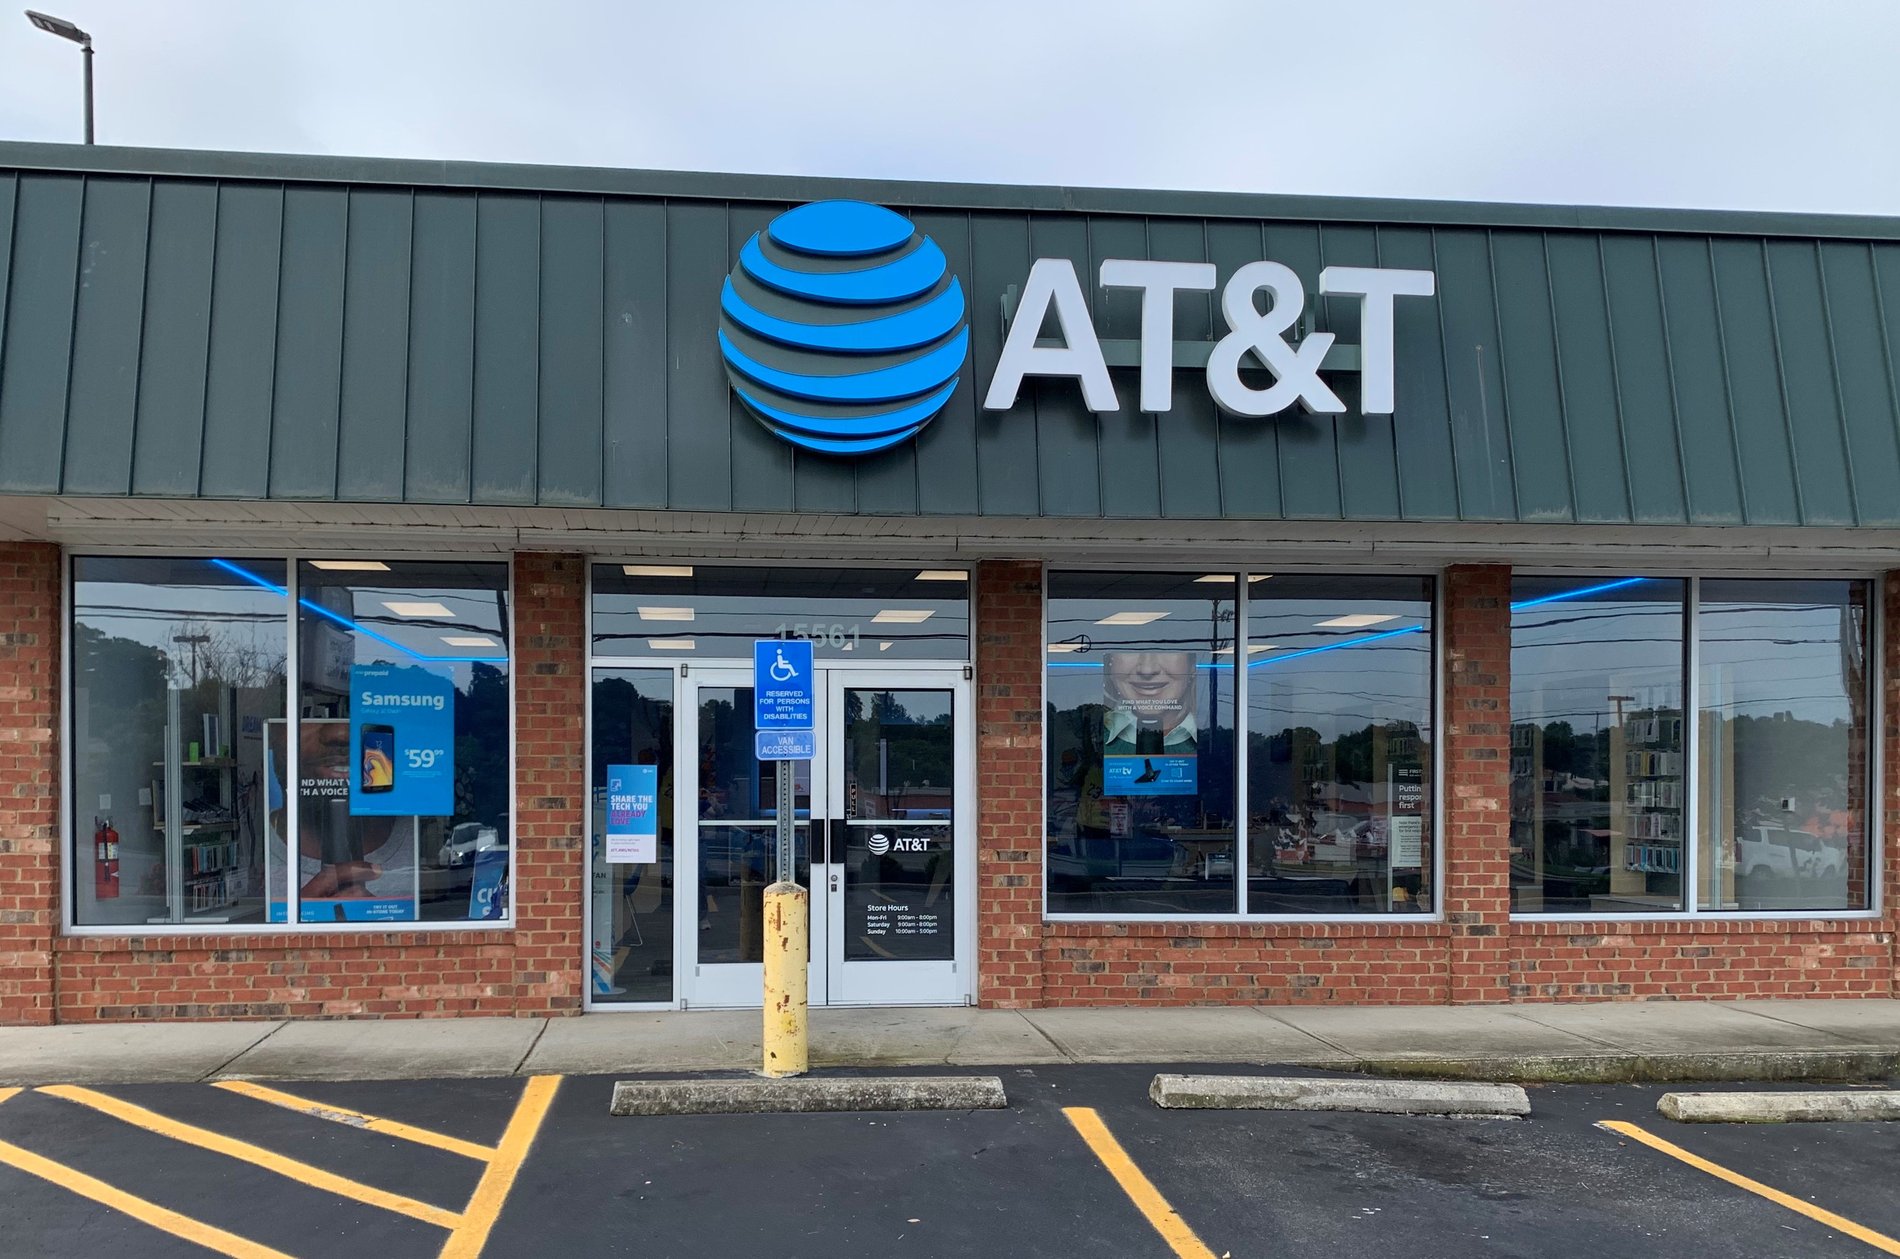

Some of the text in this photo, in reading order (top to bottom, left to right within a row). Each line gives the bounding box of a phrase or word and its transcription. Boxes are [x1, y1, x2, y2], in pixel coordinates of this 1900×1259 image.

[983, 258, 1435, 417] AT&T
[775, 623, 860, 648] 15561
[361, 691, 445, 710] Samsung
[777, 737, 794, 745] VAN
[761, 745, 811, 755] ACCESSIBLE
[312, 788, 319, 796] A
[320, 788, 348, 796] VOICE
[610, 795, 653, 803] SHARE THE
[610, 803, 648, 811] TECH YOU
[610, 810, 647, 818] ALREADY
[610, 817, 630, 825] LOVE
[893, 838, 931, 851] AT&T
[867, 904, 909, 912] Store Hours
